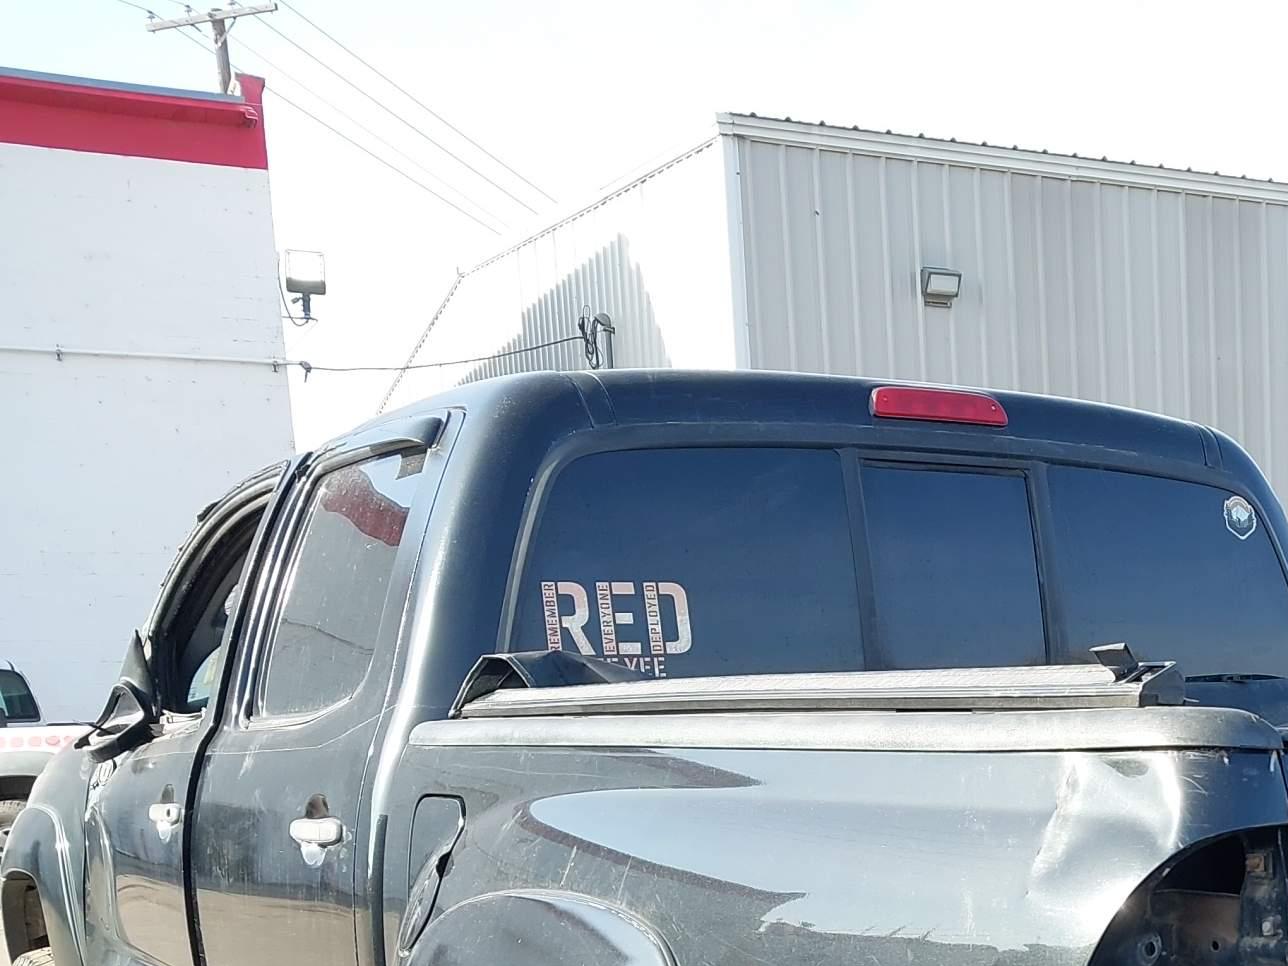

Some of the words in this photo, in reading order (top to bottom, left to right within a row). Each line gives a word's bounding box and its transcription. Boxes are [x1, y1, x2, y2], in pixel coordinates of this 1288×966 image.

[541, 581, 692, 655] RED
[543, 583, 560, 651] REMEMBER
[597, 584, 616, 654] EVERYONE
[644, 584, 662, 652] DEPLOYED
